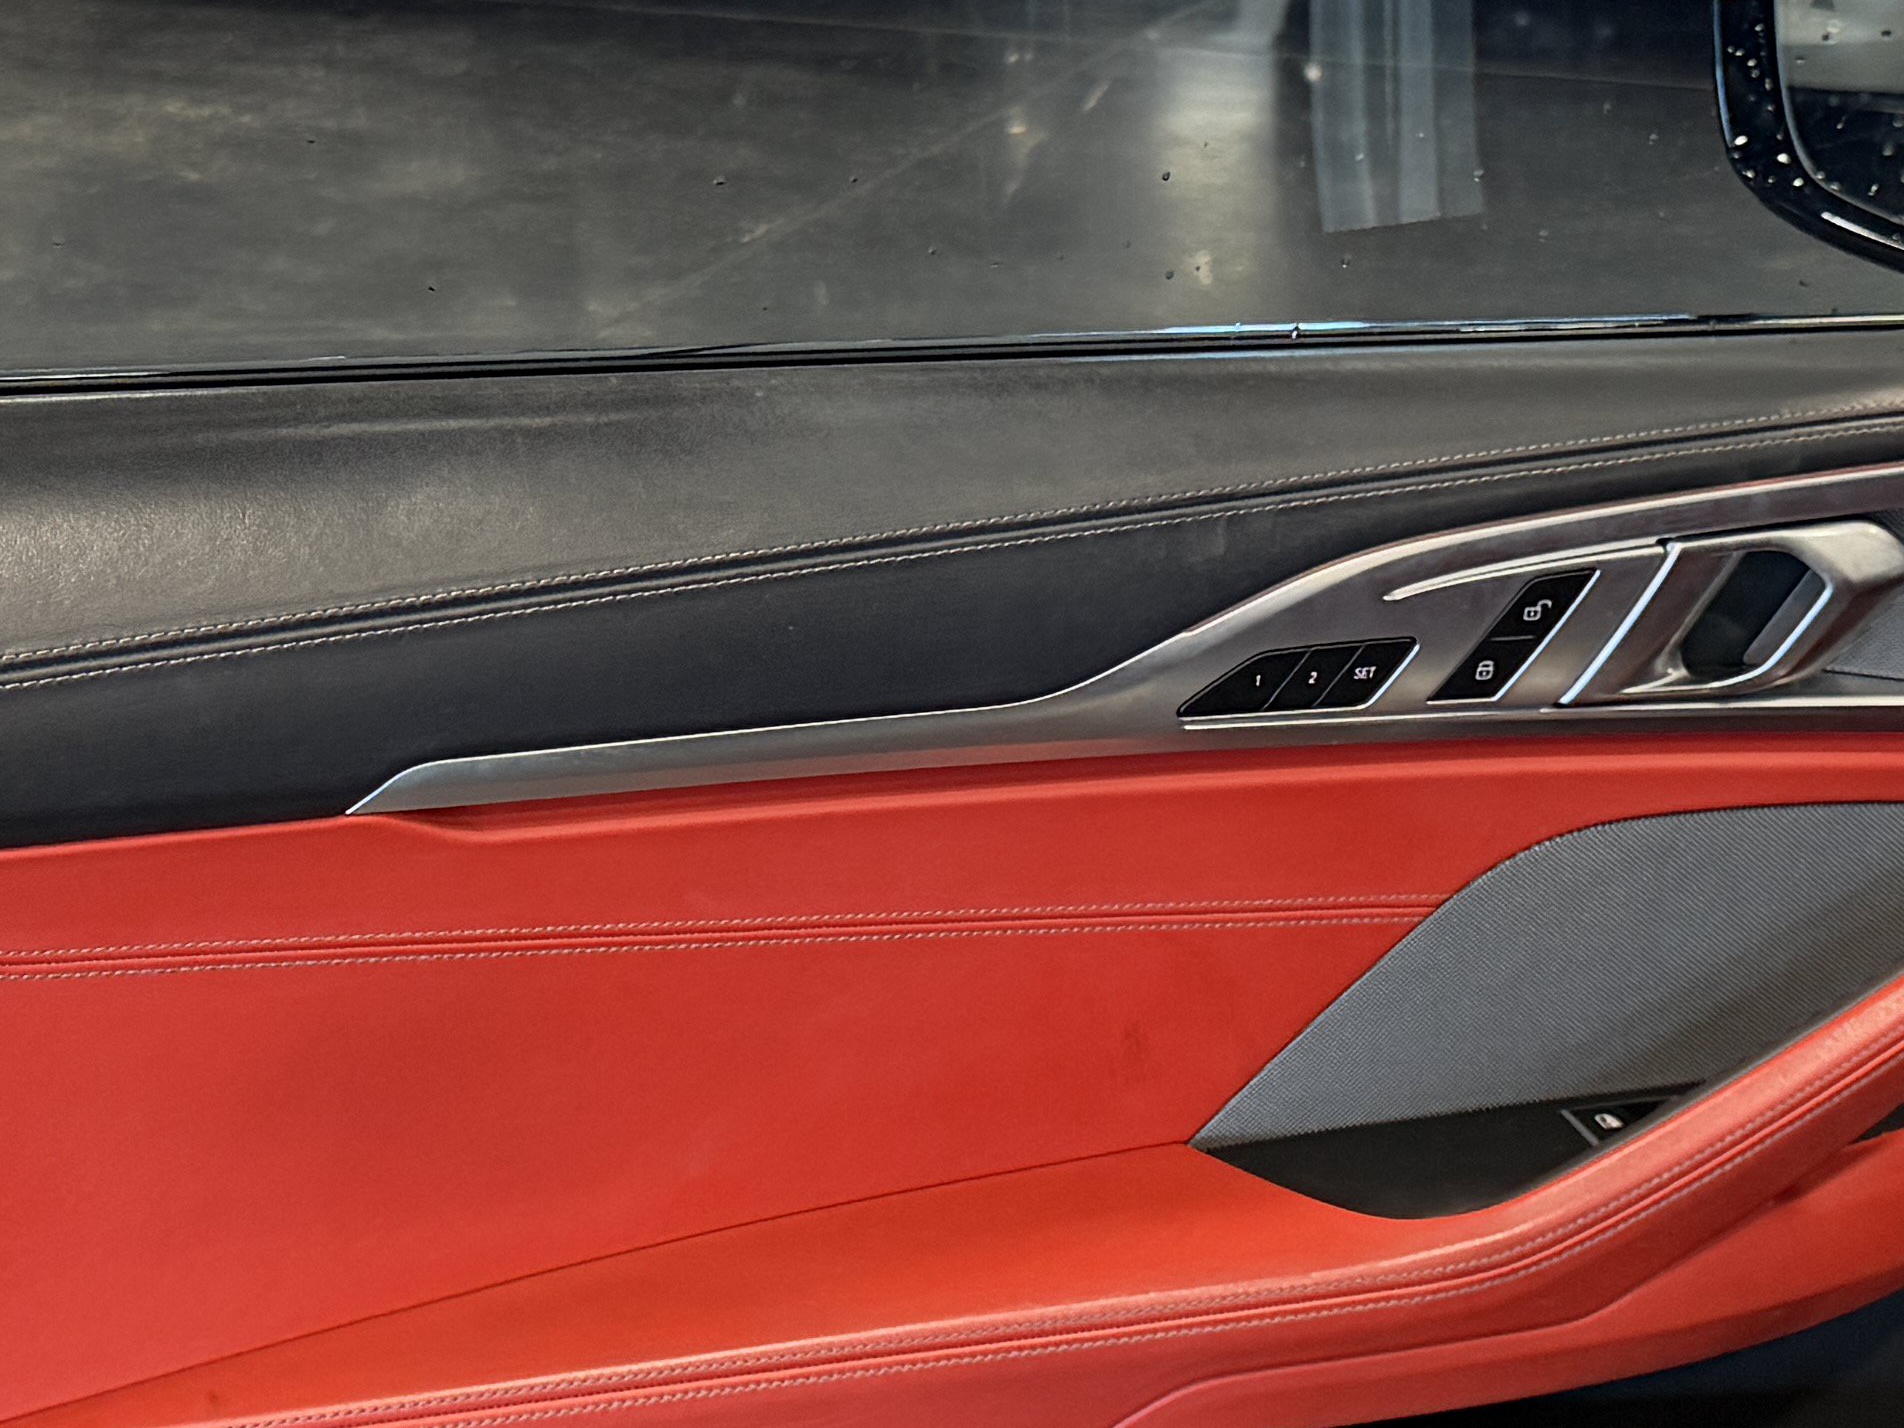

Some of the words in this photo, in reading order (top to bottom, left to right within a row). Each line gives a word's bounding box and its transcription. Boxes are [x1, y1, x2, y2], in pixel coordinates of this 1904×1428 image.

[1255, 674, 1262, 687] 1
[1307, 671, 1318, 685] 2
[1353, 665, 1377, 680] SET
